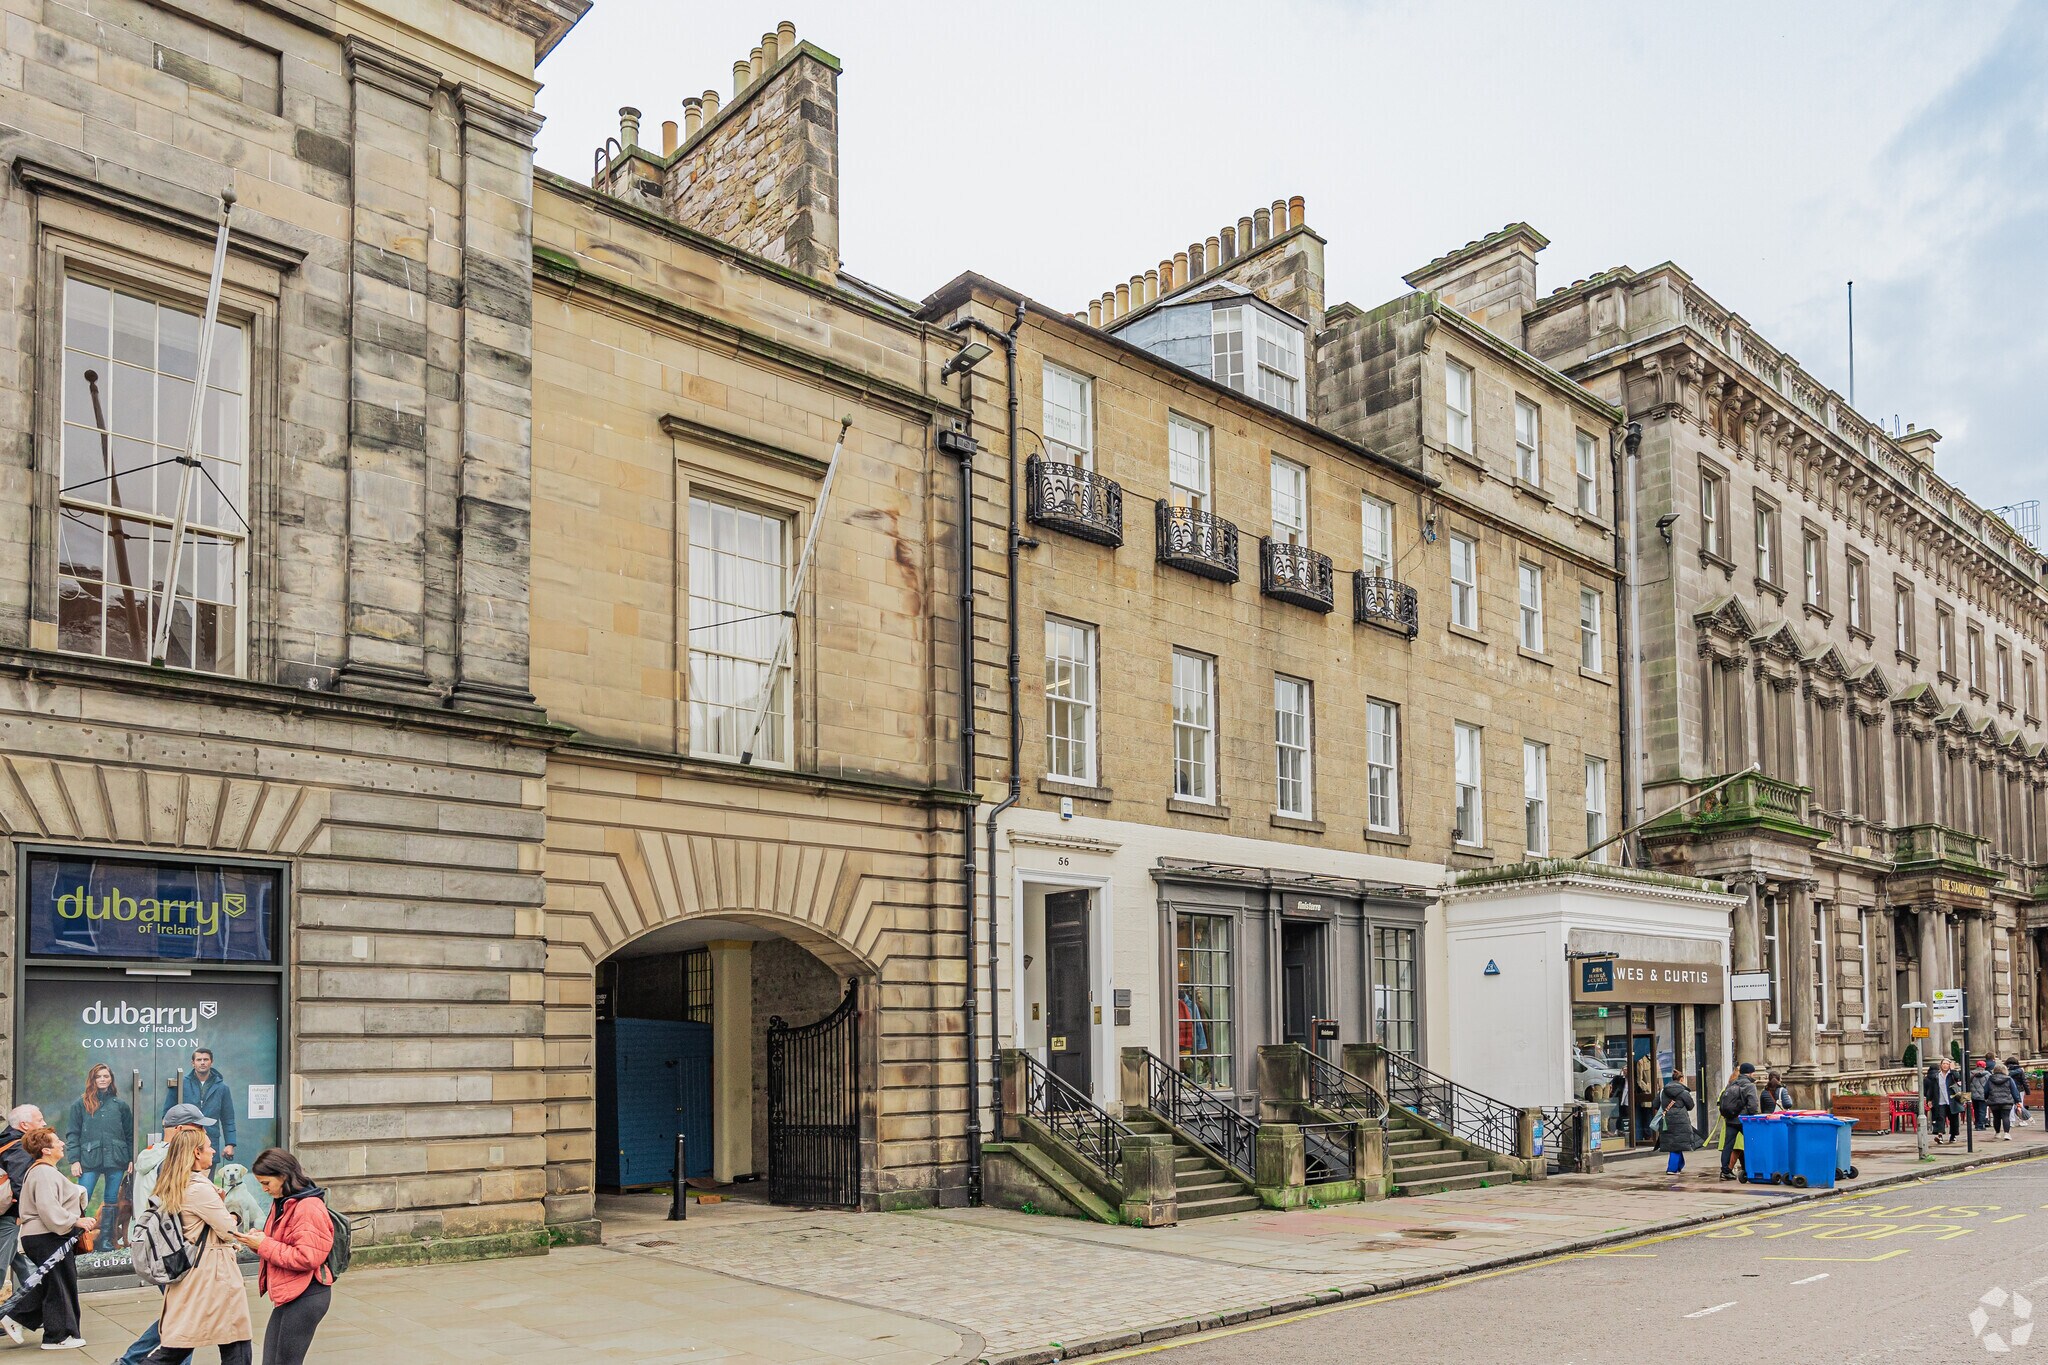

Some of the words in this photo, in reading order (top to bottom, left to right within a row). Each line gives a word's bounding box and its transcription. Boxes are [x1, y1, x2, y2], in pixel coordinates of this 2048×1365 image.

[1058, 857, 1070, 866] 56
[1941, 879, 1950, 891] THE
[1950, 881, 1973, 896] STANDING
[57, 886, 219, 936] dubarry
[138, 923, 153, 934] of
[157, 923, 201, 936] Ireland
[1612, 967, 1643, 980] WES
[1650, 969, 1657, 981] &
[1664, 969, 1708, 984] CURTIS
[82, 1000, 198, 1033] dubarry
[139, 1025, 150, 1033] of
[152, 1025, 184, 1033] Ireland
[82, 1038, 149, 1049] COMING
[156, 1038, 200, 1048] SOON
[1808, 1205, 2002, 1219] BUS
[1705, 1223, 1963, 1241] STOP
